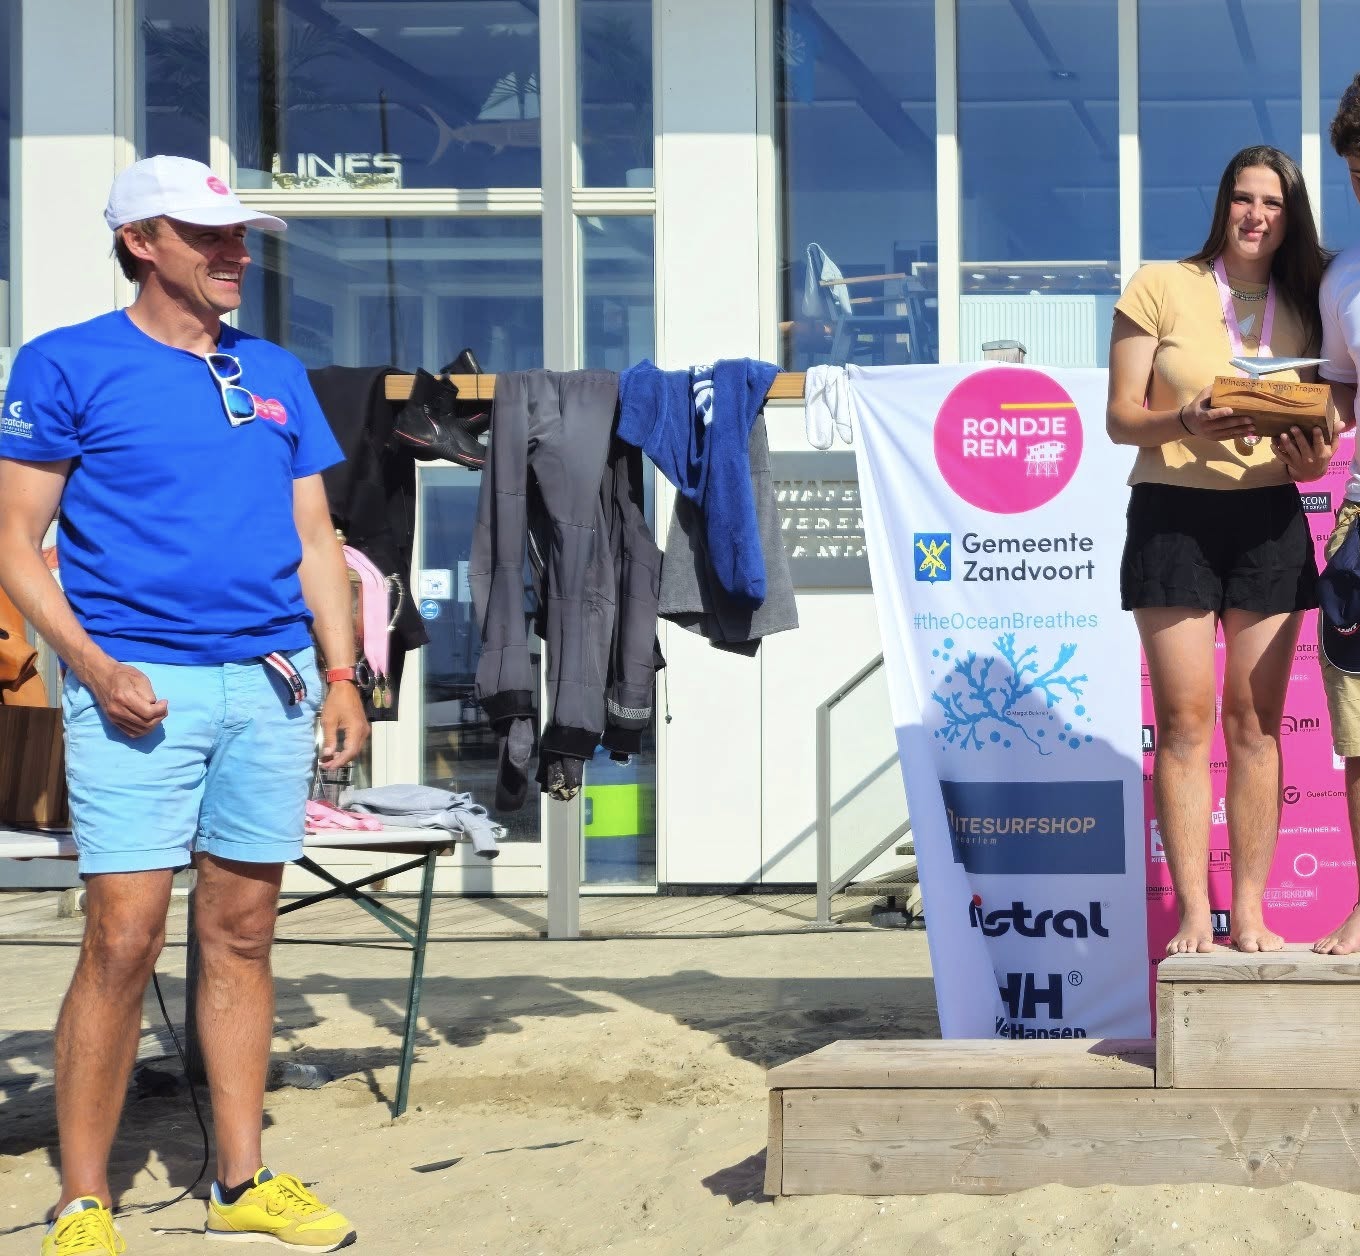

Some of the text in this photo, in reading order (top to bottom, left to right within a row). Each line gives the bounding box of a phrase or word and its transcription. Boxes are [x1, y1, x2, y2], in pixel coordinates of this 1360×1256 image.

[272, 152, 402, 178] LINES
[962, 417, 1067, 436] RONDJE
[962, 438, 1017, 457] REM
[962, 532, 1094, 553] Gemeente
[963, 559, 1095, 582] Zandvoort
[913, 611, 1098, 630] #theOceanBreathes
[949, 812, 1096, 834] ITESURFSHOP
